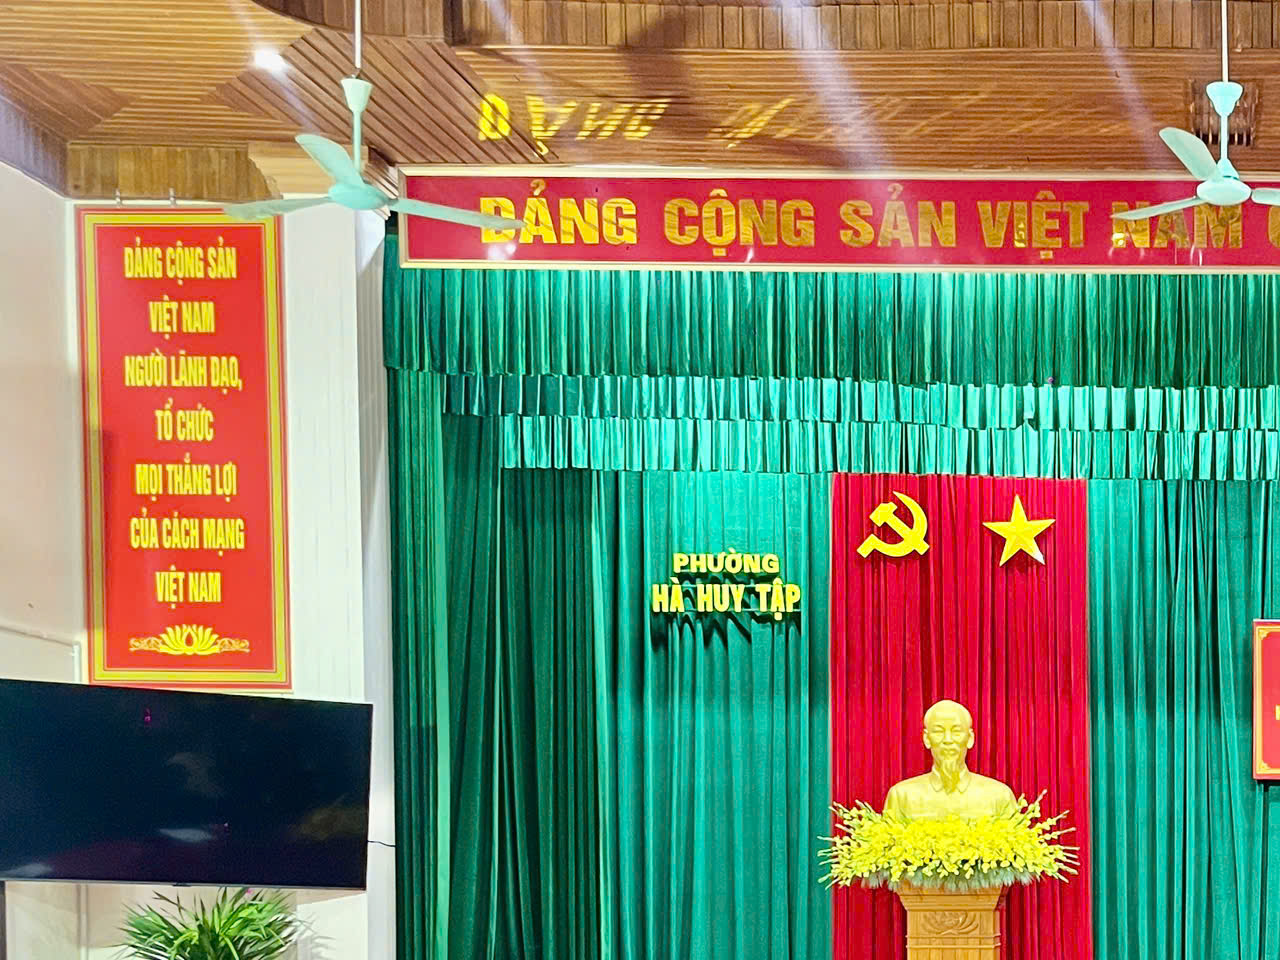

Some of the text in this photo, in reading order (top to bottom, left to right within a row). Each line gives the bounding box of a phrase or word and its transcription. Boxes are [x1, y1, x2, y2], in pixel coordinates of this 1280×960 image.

[664, 188, 815, 256] CỘNG
[839, 183, 957, 247] SẢN
[977, 190, 1090, 259] VIỆT
[1112, 201, 1243, 248] NAM
[124, 237, 236, 285] ĐẢNG CỘNG SẢN
[149, 295, 215, 339] VIỆT NAM
[124, 351, 168, 387] NGƯỜI
[170, 350, 207, 387] LÃNH
[155, 398, 214, 441] TỔ CHỨC
[136, 453, 236, 502] MỌI THẮNG LỢI
[130, 507, 244, 556] CỦA CÁCH MẠNG
[673, 547, 780, 573] PHƯỜNG
[155, 565, 221, 609] VIỆT NAM
[652, 576, 801, 621] HÀ HUY TẬP
